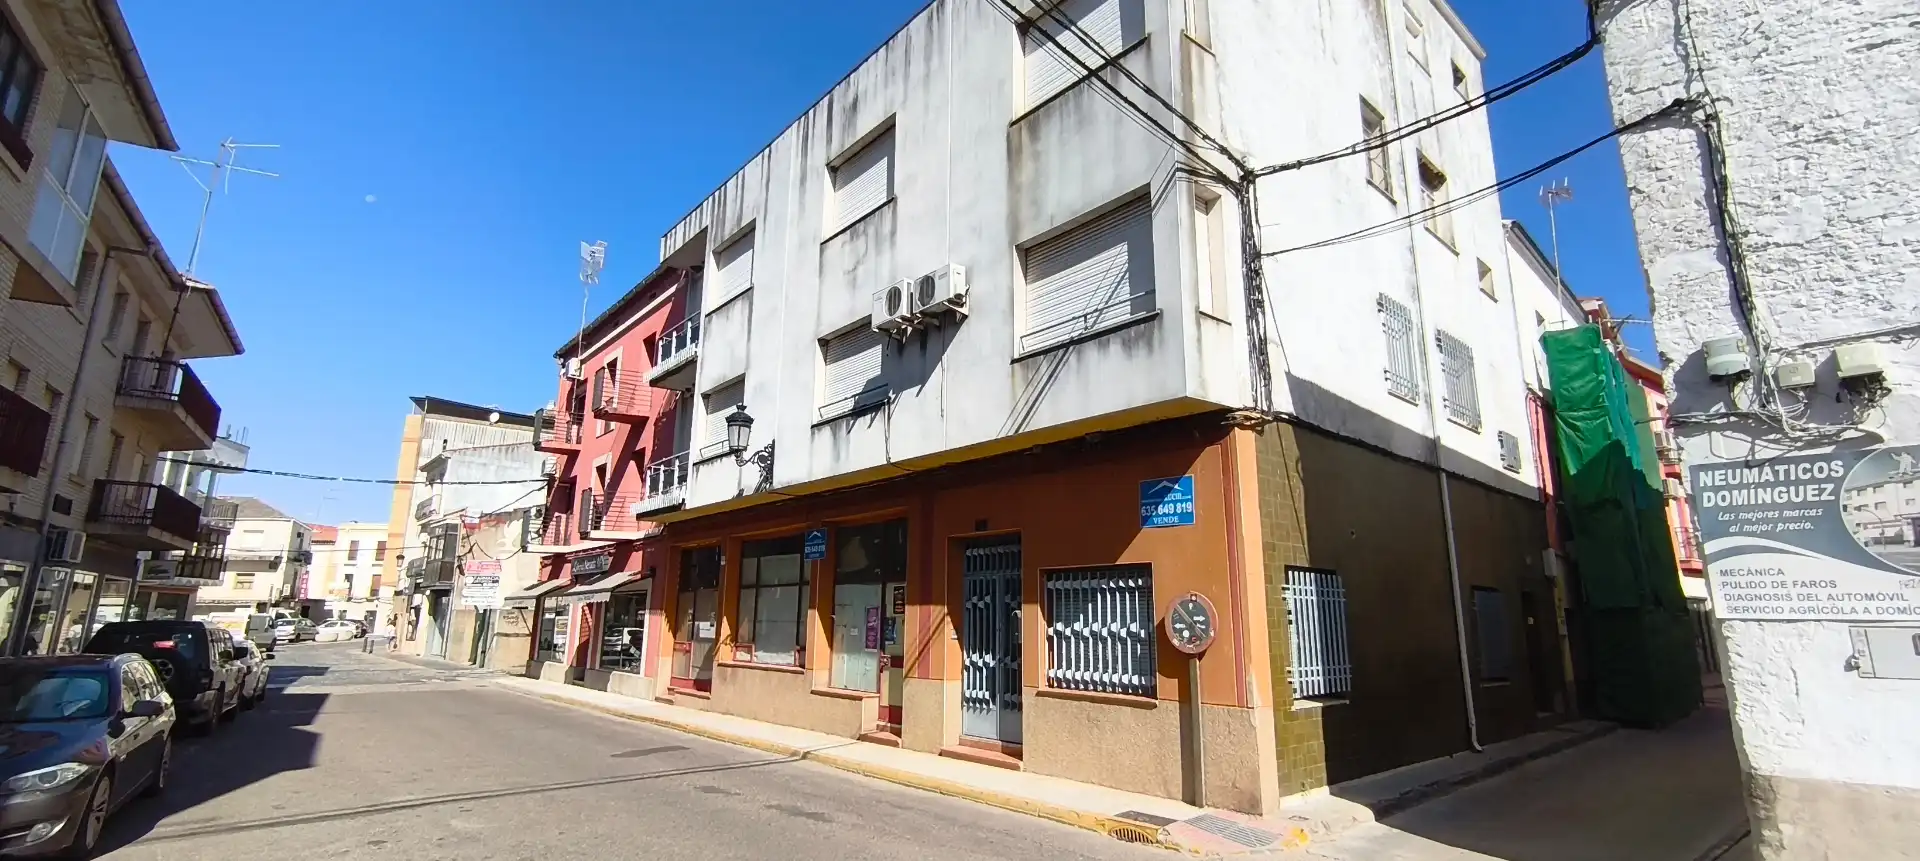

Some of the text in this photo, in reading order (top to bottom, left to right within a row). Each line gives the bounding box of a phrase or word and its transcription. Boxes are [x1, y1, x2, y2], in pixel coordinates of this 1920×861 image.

[1699, 460, 1844, 486] NEUMÁTICOS
[1702, 483, 1835, 507] DOMÍNGUEZ
[1141, 501, 1192, 516] 635 649 819
[1718, 507, 1823, 522] Las mejores marcas
[1153, 516, 1179, 524] VENDE
[1729, 519, 1815, 534] al mejor precio.
[1722, 579, 1837, 589] PULIDO DE FAROS
[1724, 592, 1793, 602] DIAGNOSIS
[1797, 593, 1823, 602] DEL
[1726, 605, 1784, 615] SERVICIO
[1862, 606, 1873, 616] A
